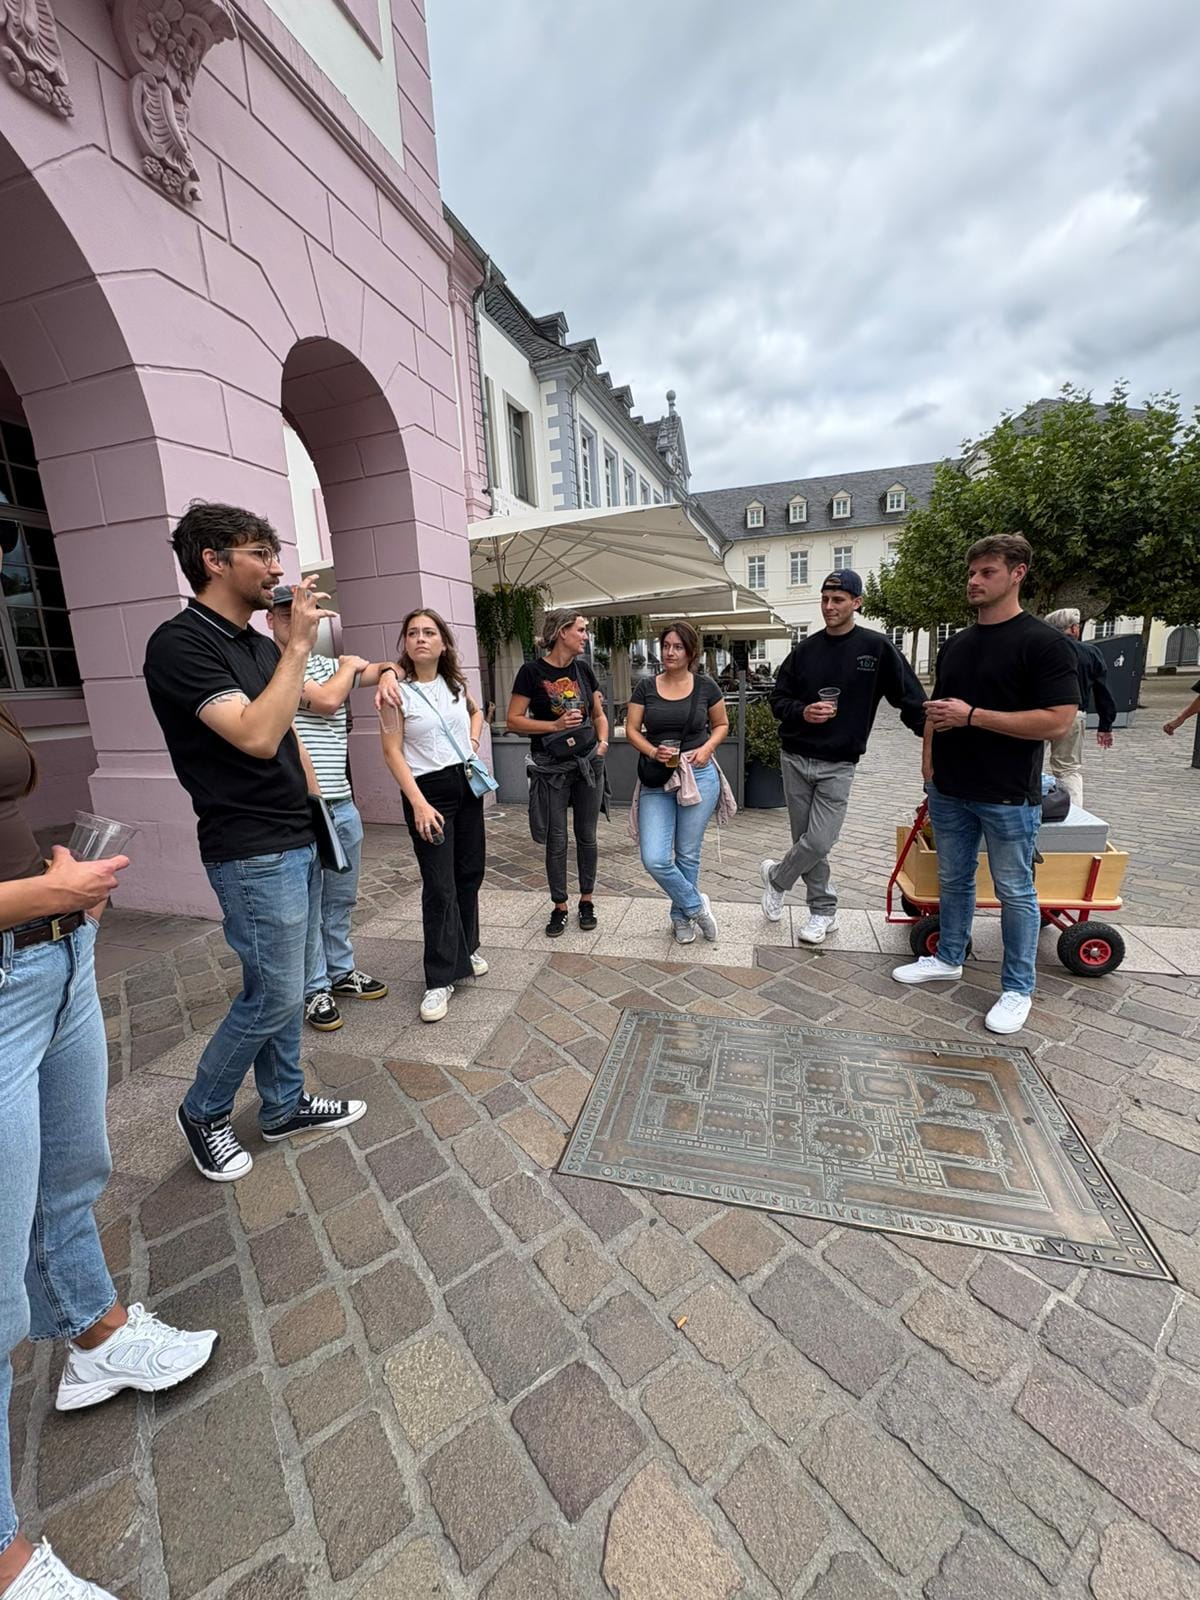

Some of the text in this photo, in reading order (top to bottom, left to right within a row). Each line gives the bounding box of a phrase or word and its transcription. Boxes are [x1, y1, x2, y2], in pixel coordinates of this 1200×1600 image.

[567, 1011, 638, 1170] EKONSTRUIERTER GRUNDRISS
[661, 1175, 693, 1191] UM
[1025, 1079, 1064, 1122] DOMES
[1057, 1133, 1090, 1165] UND
[1084, 1176, 1119, 1211] DER
[711, 1183, 861, 1220] BAUZUSTAND
